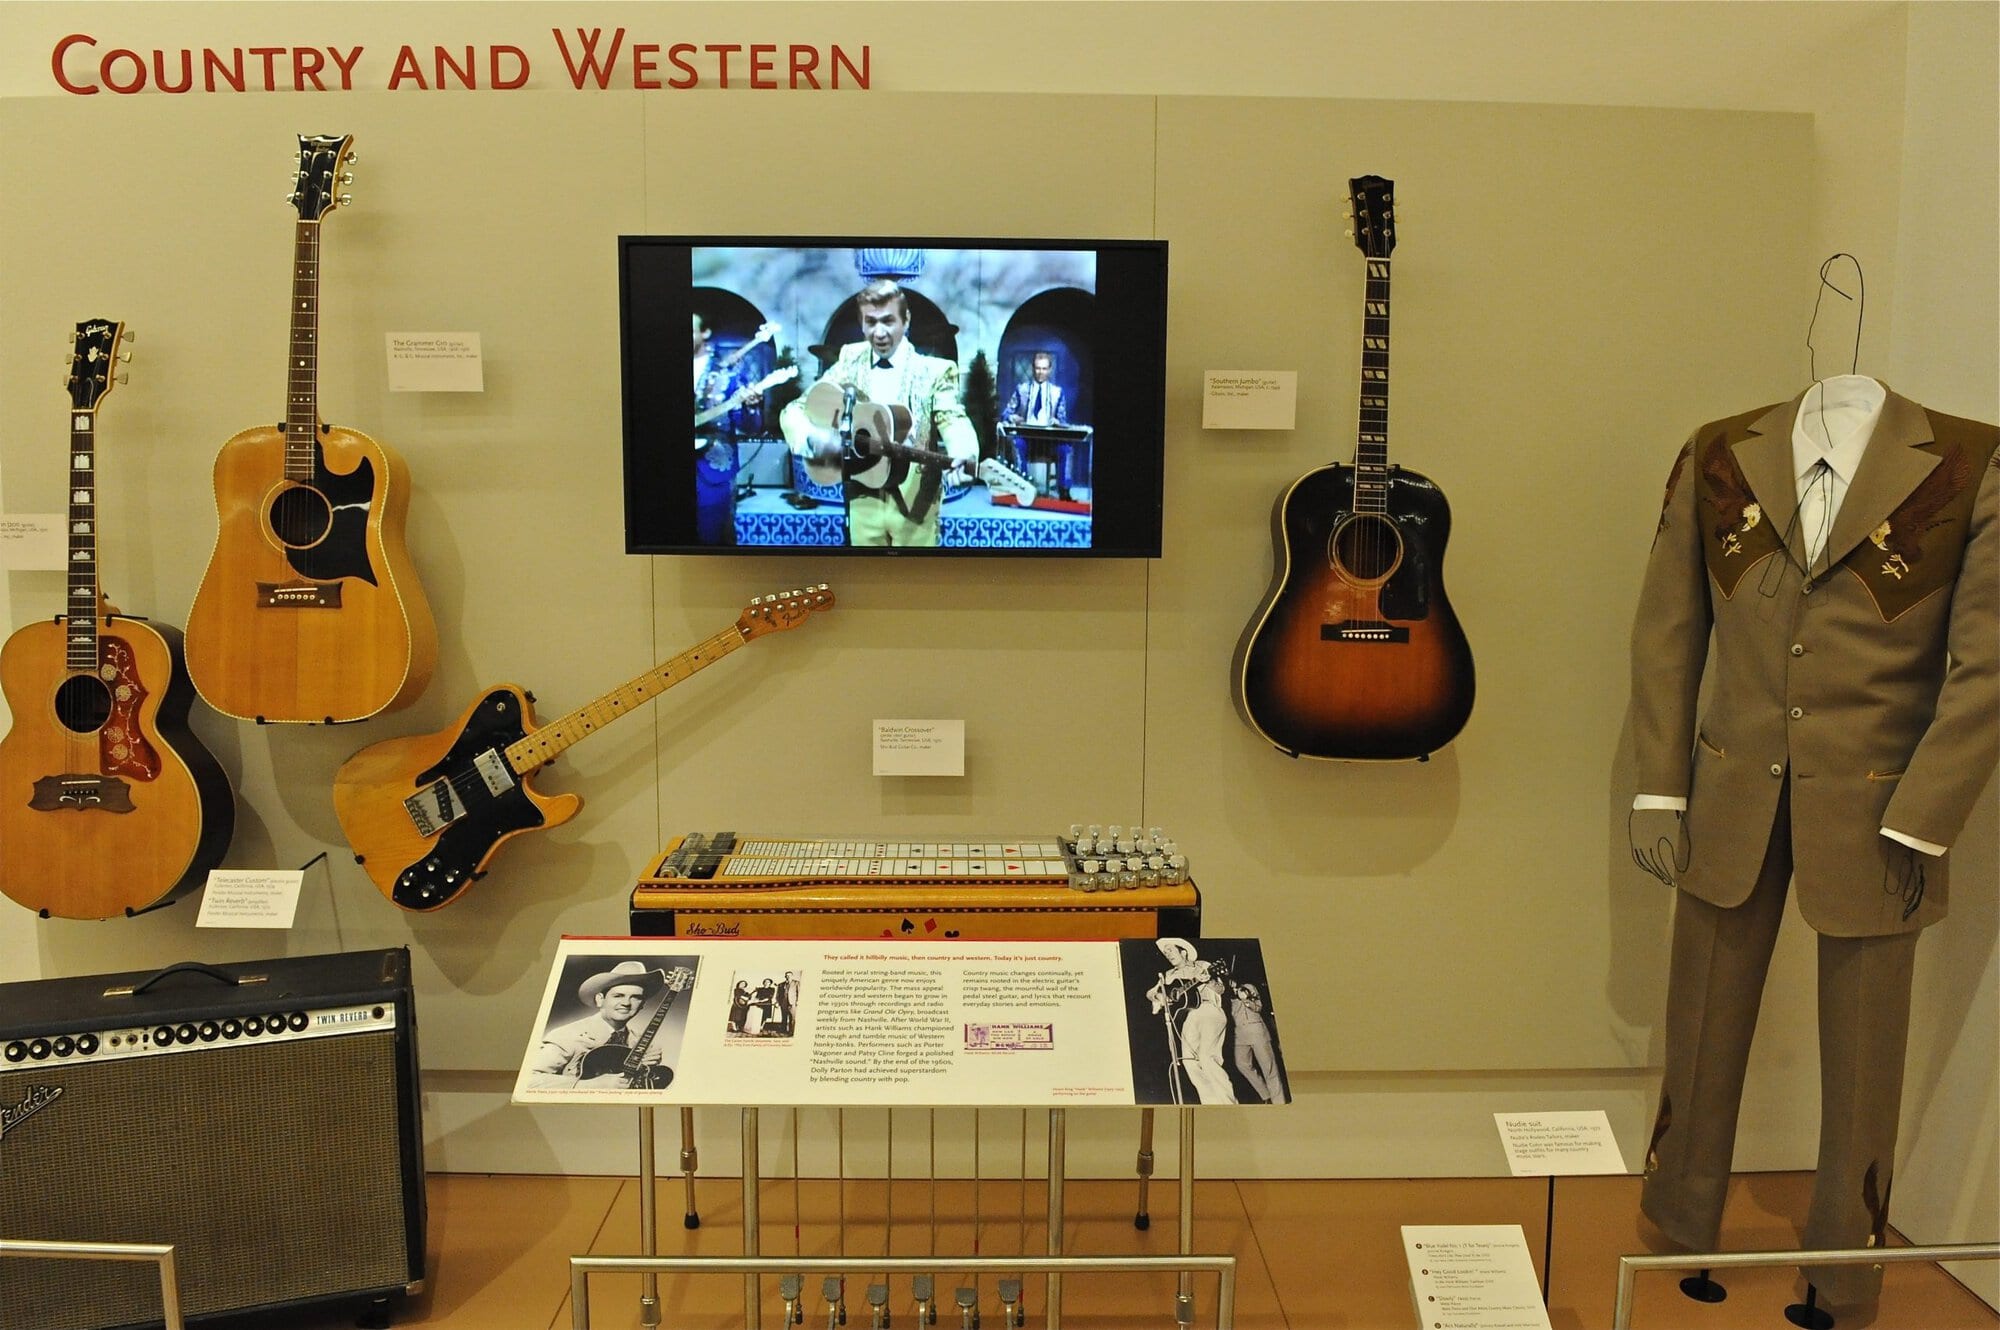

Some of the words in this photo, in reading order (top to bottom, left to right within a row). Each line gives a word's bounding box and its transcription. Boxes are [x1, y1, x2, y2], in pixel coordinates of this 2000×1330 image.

[52, 34, 364, 94] COUNTRY
[388, 45, 531, 91] AND
[552, 28, 870, 90] WESTERN
[317, 1014, 336, 1024] TWIN
[340, 1011, 368, 1022] REVERB
[0, 1086, 63, 1139] ender
